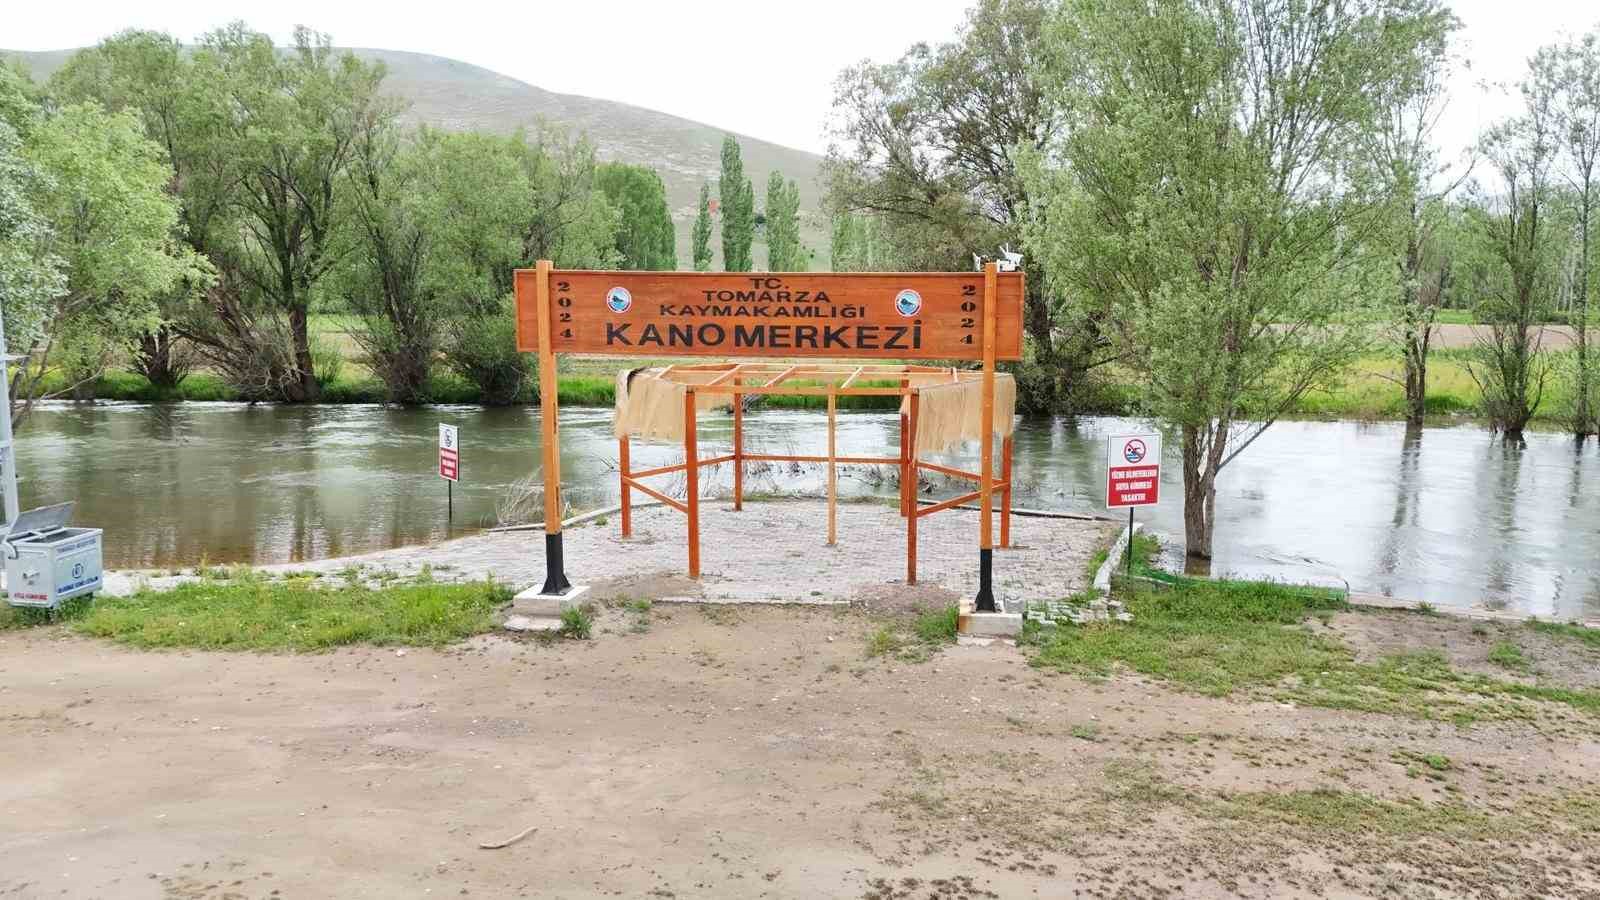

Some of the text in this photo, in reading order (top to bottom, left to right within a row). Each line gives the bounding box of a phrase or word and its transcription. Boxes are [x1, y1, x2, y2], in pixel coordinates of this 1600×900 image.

[556, 281, 573, 338] 2024
[660, 304, 866, 318] KAYMAKAMLIĞI
[702, 290, 831, 302] TOMARZA
[959, 284, 977, 344] 2024
[606, 320, 922, 350] KANO MERKEZİ
